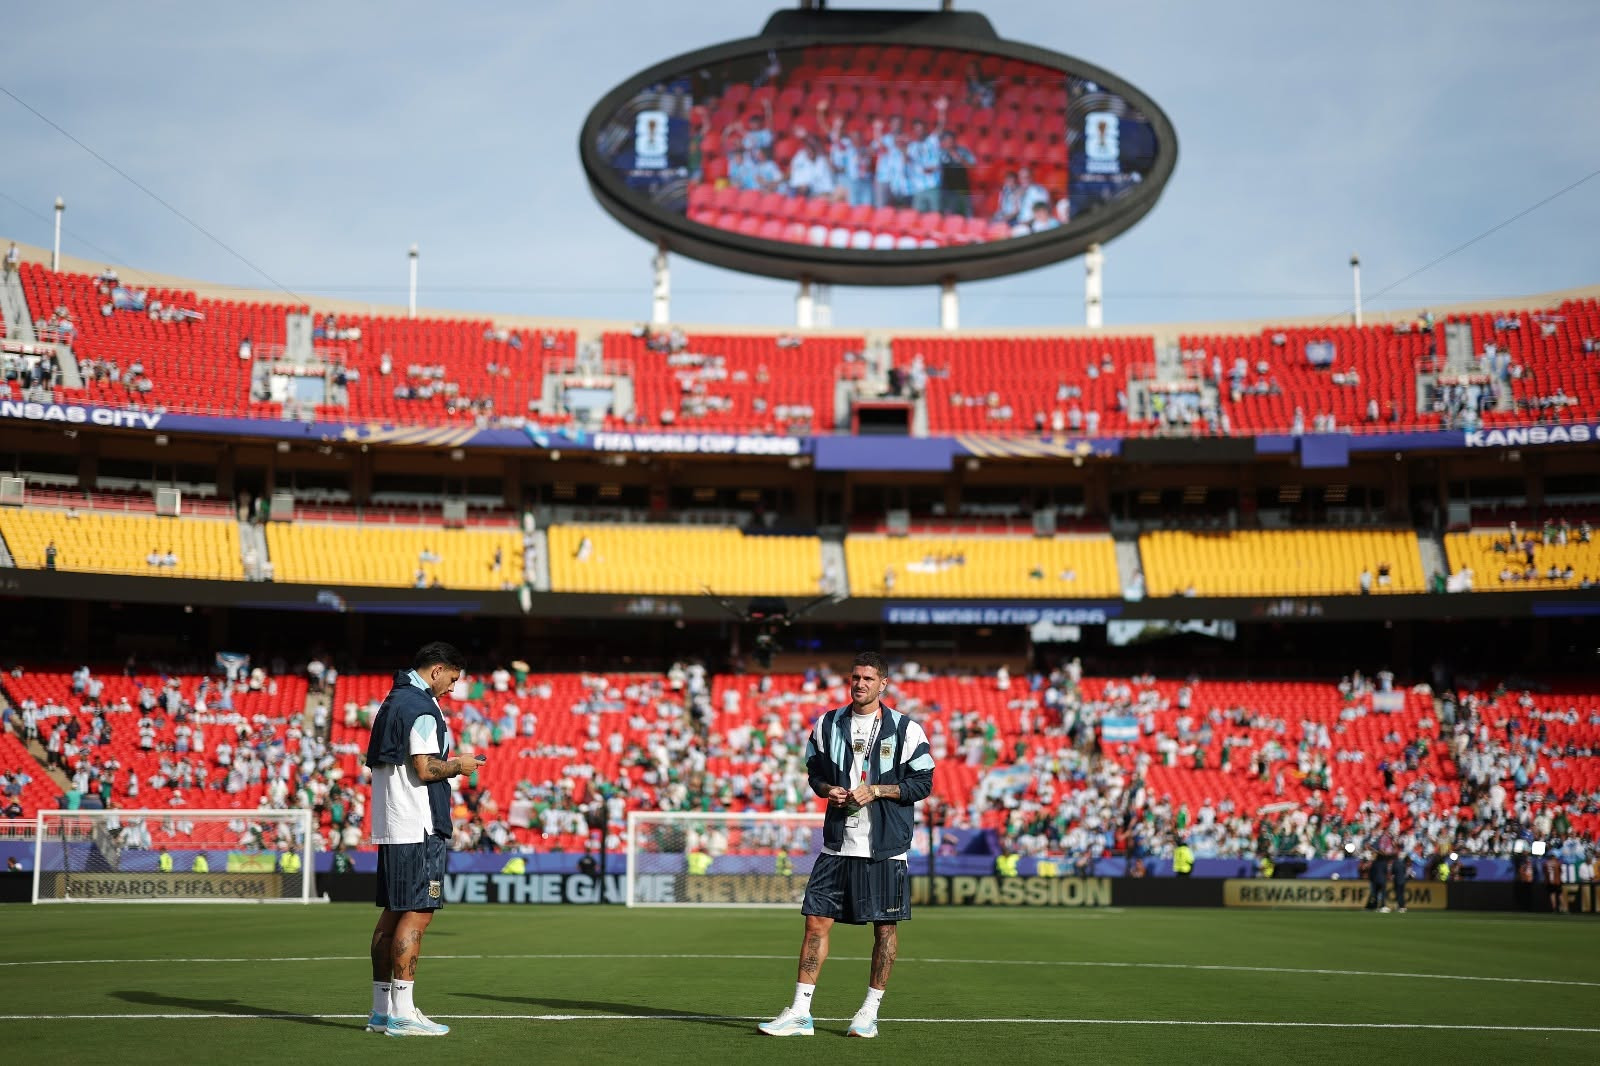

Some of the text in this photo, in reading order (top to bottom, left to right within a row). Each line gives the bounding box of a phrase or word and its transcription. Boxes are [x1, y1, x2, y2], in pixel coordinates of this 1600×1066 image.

[92, 408, 161, 429] CITY
[1465, 425, 1590, 447] KANSAS
[72, 880, 266, 896] REWARDS.FIFA.COM
[492, 874, 562, 904] THE
[565, 874, 675, 904] GAME
[953, 876, 1112, 905] PASSION
